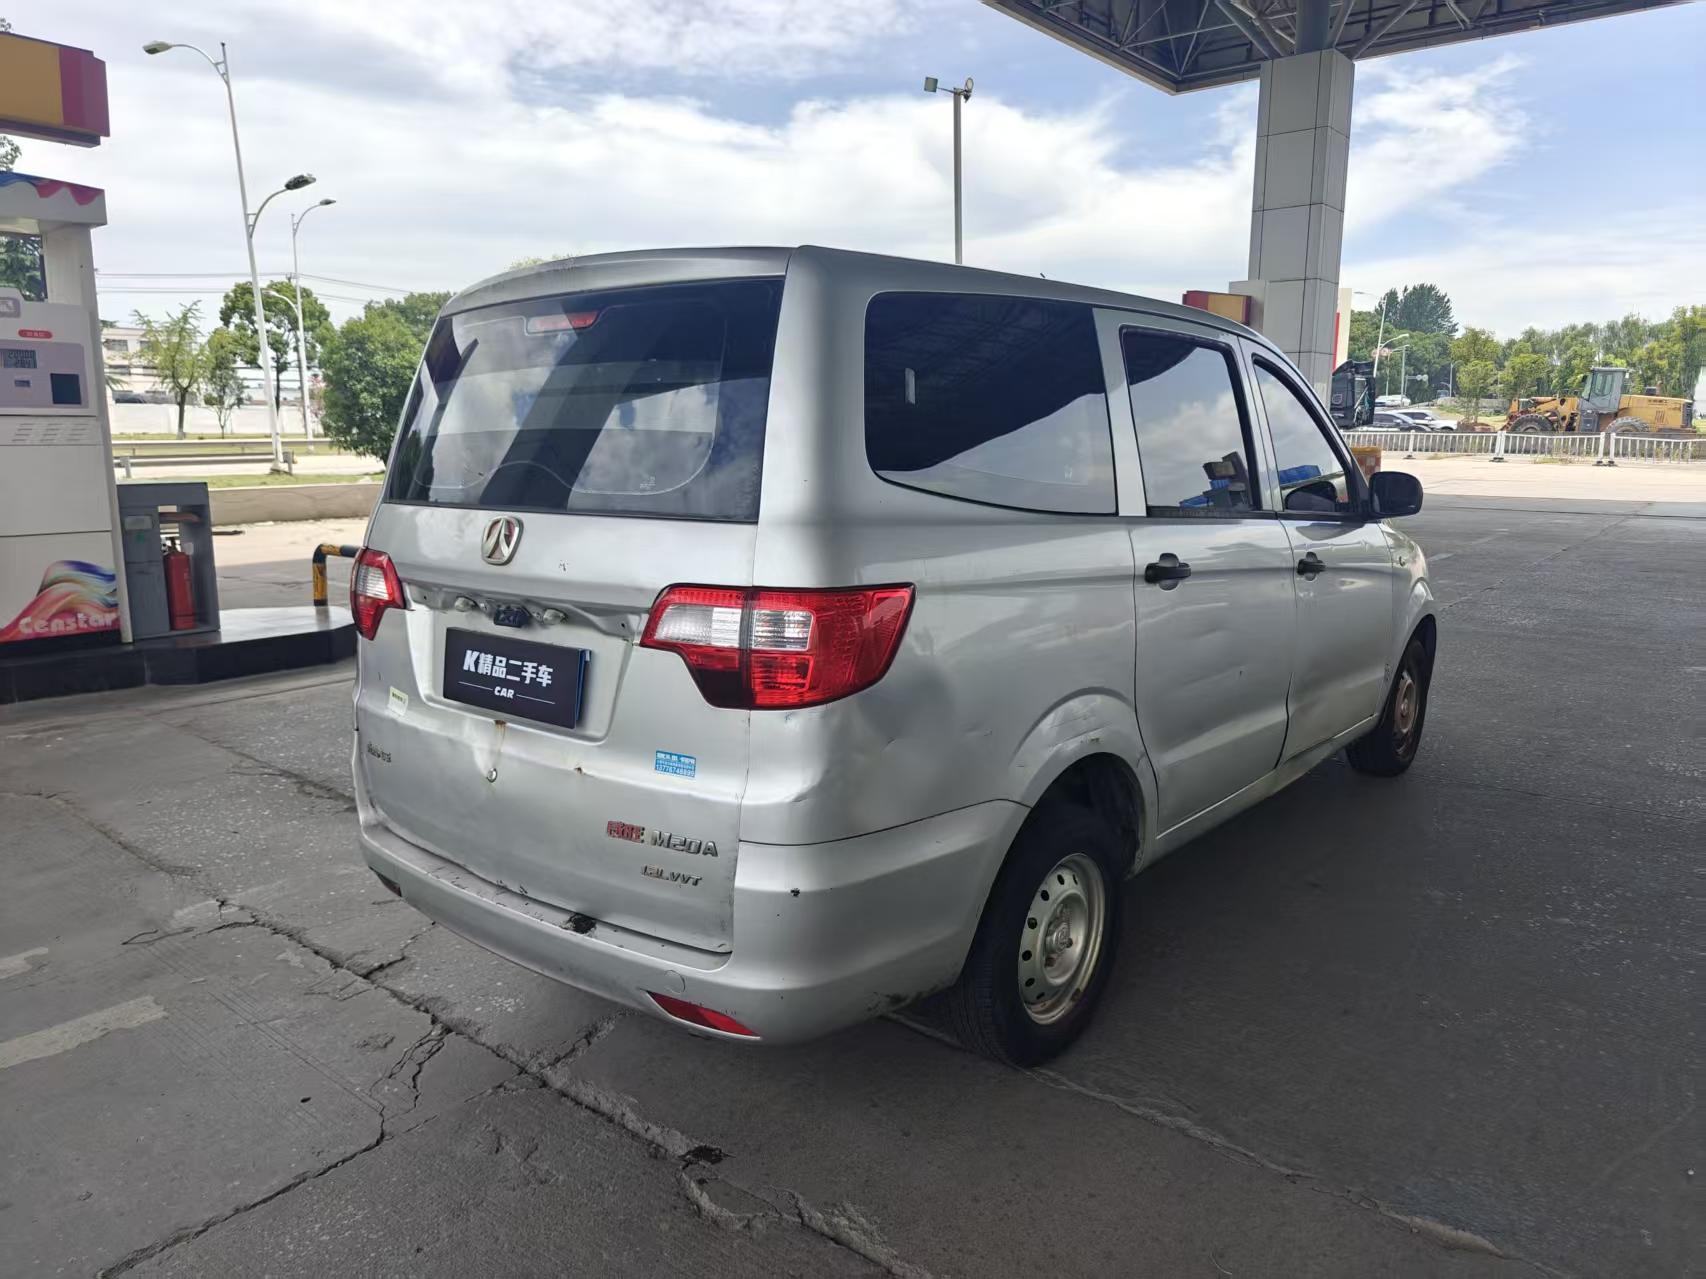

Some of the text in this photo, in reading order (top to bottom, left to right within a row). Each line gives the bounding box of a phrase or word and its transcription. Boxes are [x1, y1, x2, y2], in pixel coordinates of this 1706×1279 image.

[19, 612, 117, 634] Censtar
[462, 650, 554, 687] K精品二手车
[494, 686, 515, 699] CAR
[651, 830, 719, 857] M20A
